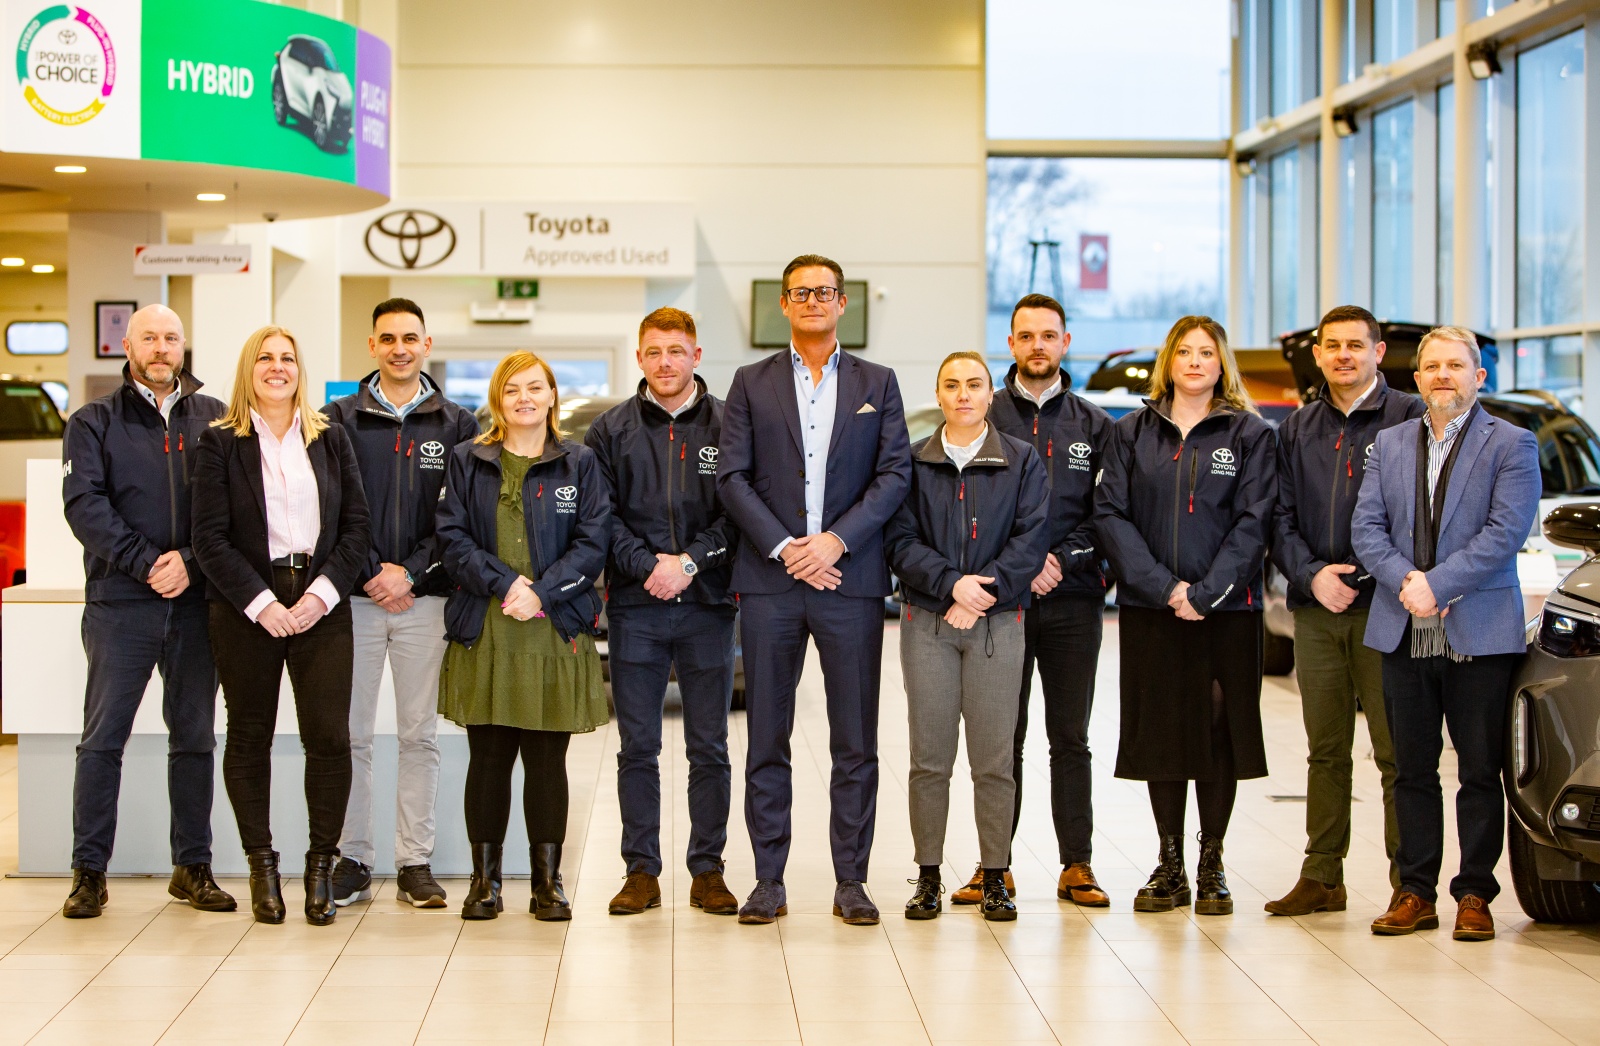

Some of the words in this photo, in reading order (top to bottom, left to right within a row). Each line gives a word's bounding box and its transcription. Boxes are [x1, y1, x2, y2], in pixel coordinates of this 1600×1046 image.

[39, 51, 81, 64] POWER
[83, 54, 98, 65] OF
[35, 64, 98, 84] CHOICE
[167, 58, 255, 99] HYBRID
[524, 211, 611, 241] Toyota
[141, 255, 183, 265] Customer
[186, 255, 219, 266] Waiting
[222, 255, 243, 264] Area
[523, 245, 617, 268] Approved
[620, 245, 669, 266] Used
[419, 457, 444, 465] TOYOTA
[698, 462, 717, 470] TOYO
[1069, 457, 1090, 466] TOYOTA
[1211, 462, 1237, 471] TOYOTA
